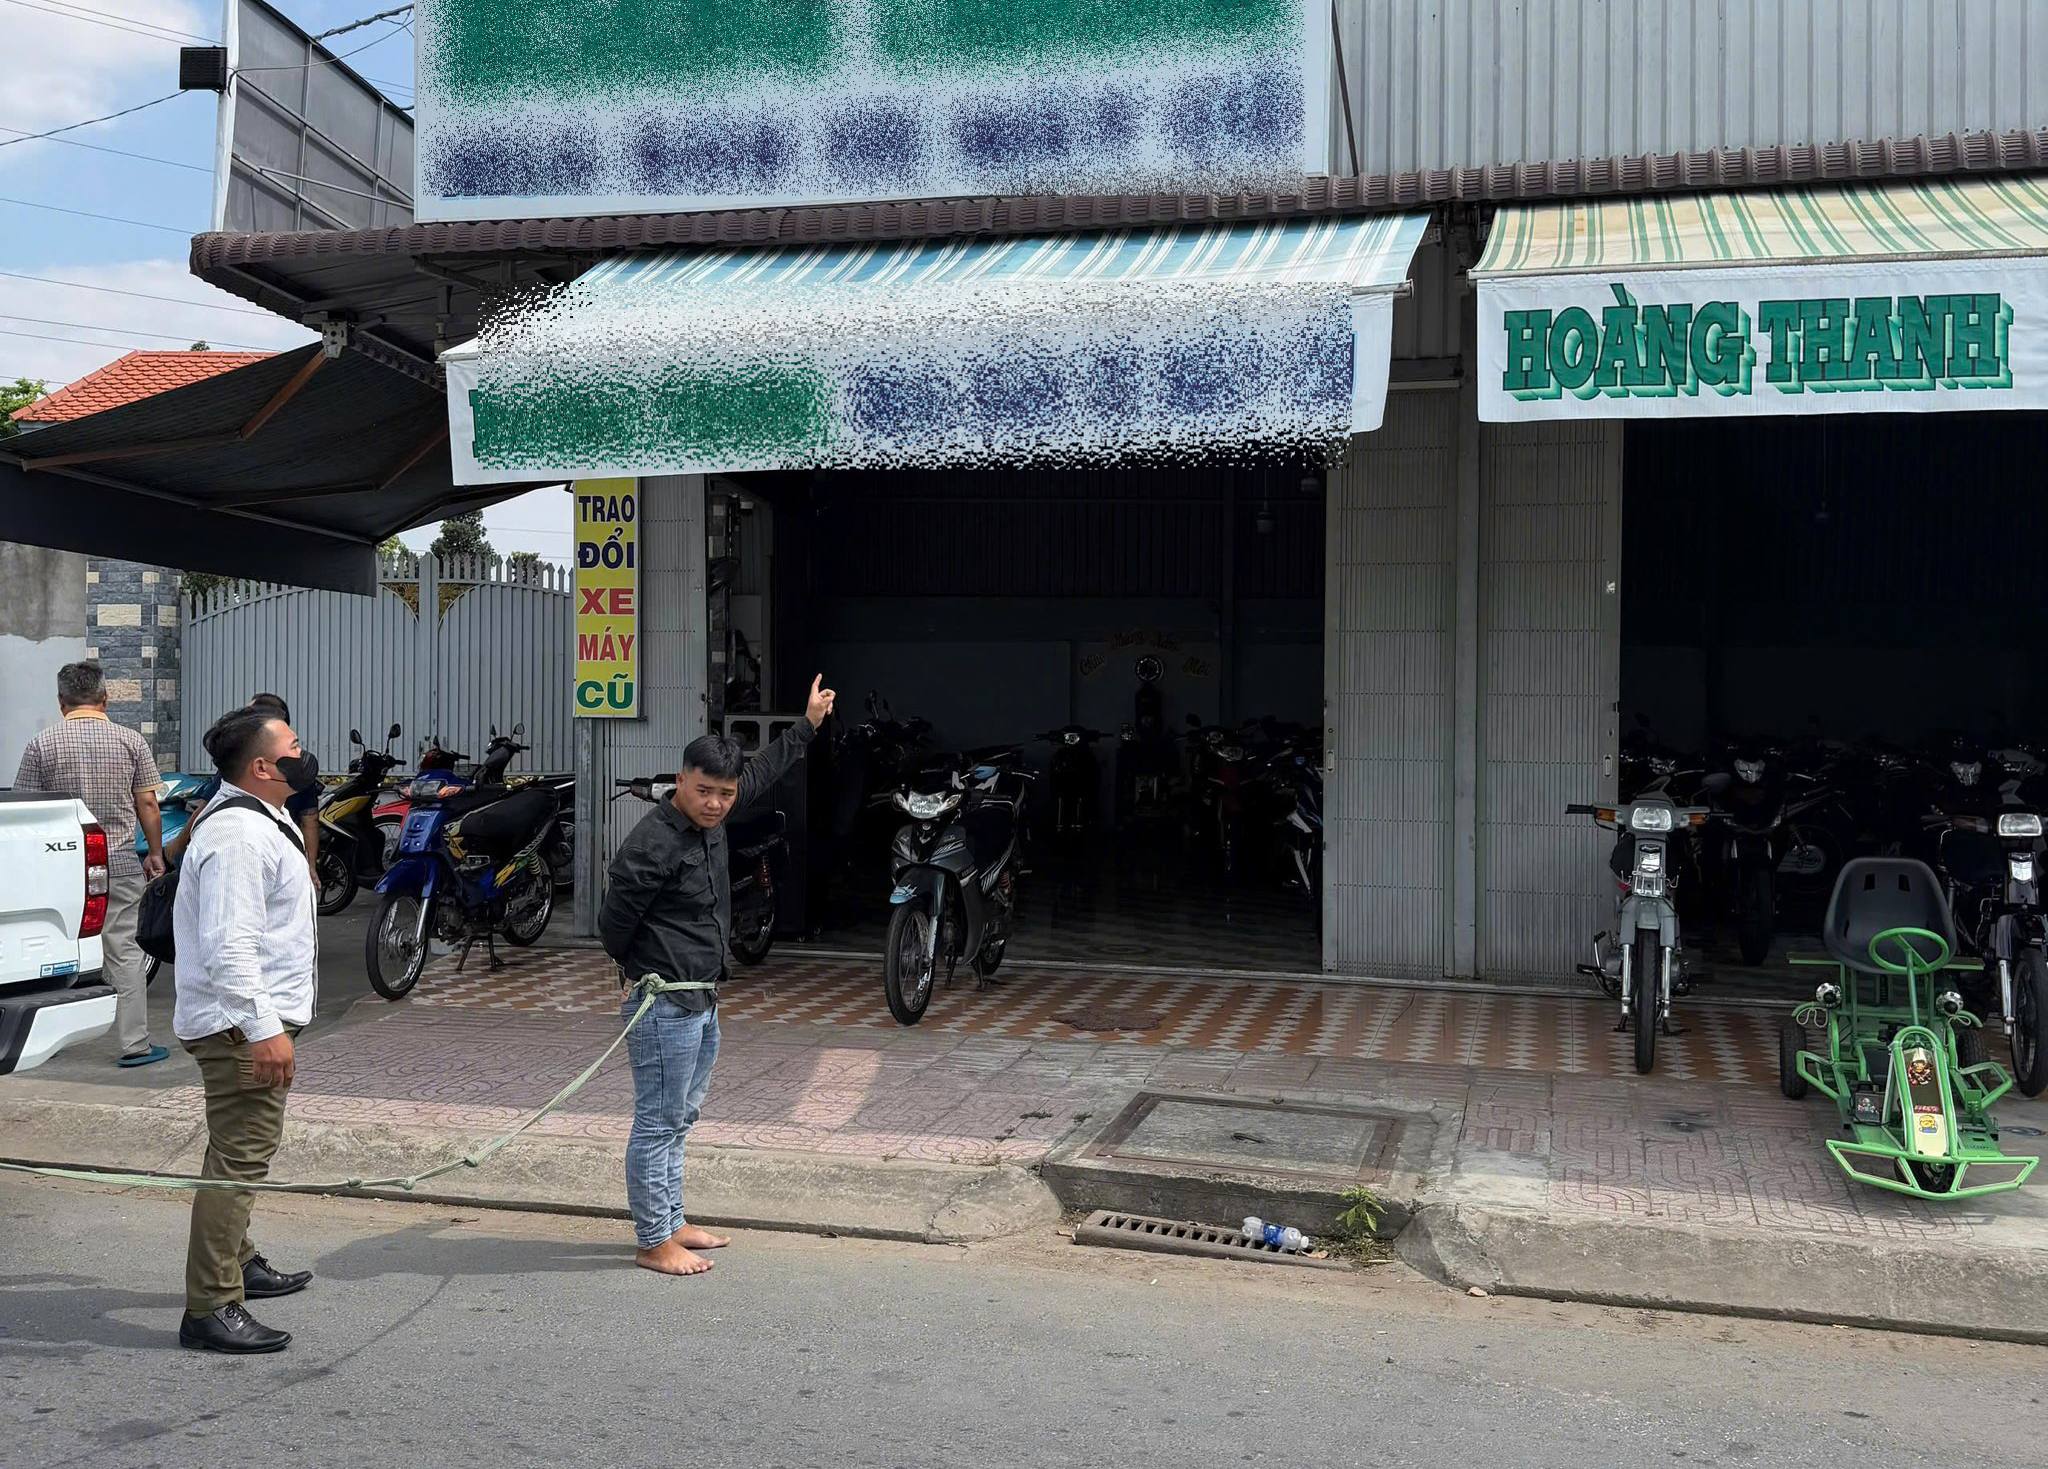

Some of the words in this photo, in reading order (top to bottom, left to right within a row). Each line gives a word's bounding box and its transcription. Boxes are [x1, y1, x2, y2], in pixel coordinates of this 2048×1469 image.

[1503, 283, 1756, 401] HOÀNG
[1759, 292, 2014, 395] THANH
[578, 495, 635, 523] TRAO
[577, 527, 635, 569] ĐỔI
[579, 588, 635, 615] XE
[578, 626, 635, 661] MÁY
[576, 673, 634, 710] CŨ
[45, 842, 77, 852] XLS
